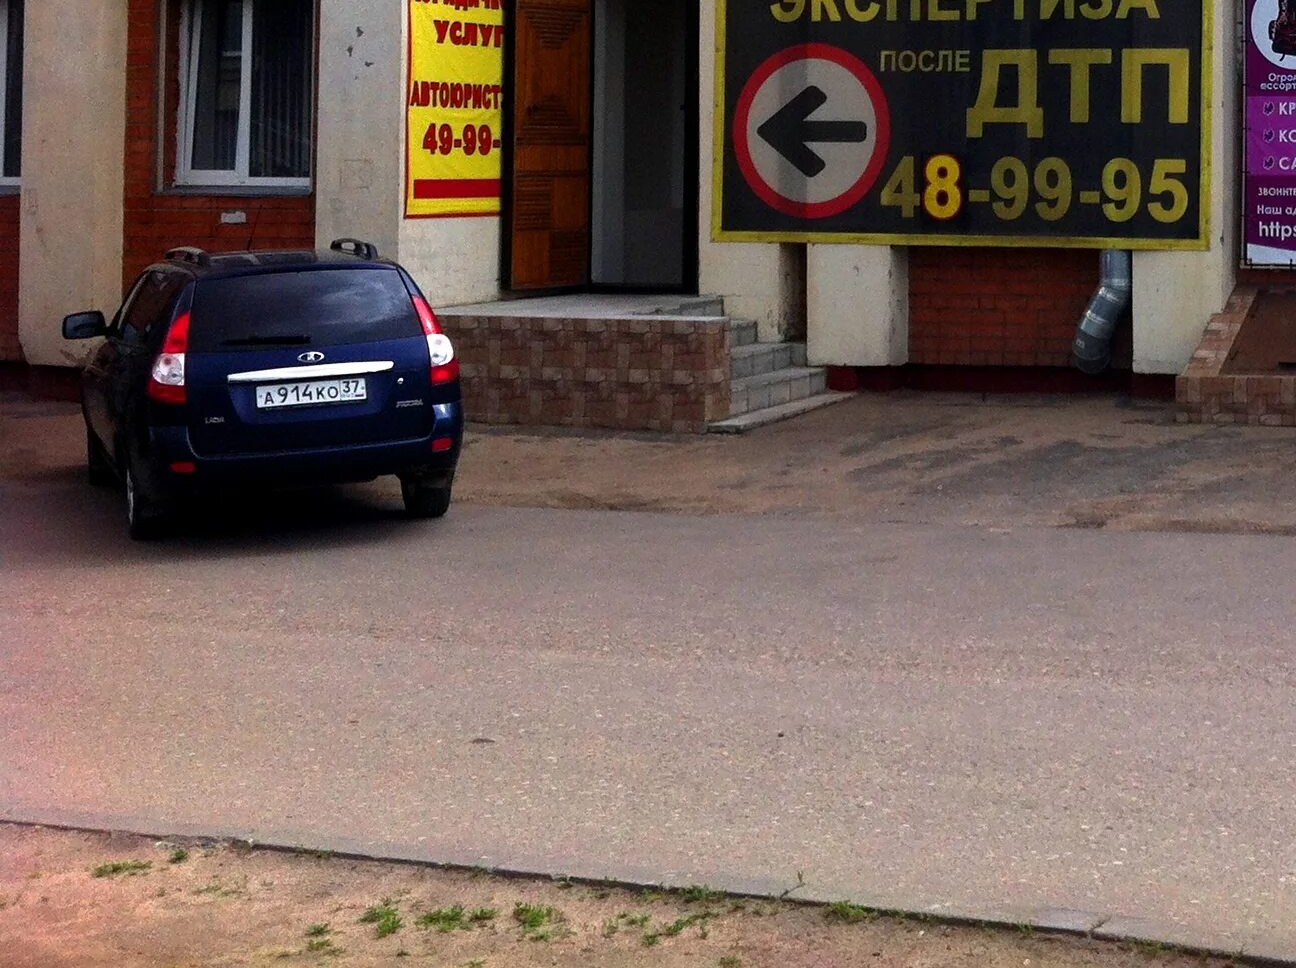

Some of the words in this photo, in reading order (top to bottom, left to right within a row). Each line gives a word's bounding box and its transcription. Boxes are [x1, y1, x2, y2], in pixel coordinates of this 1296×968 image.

[410, 80, 503, 110] АВТОЮРИСТ
[880, 49, 970, 73] ПОСЛЕ
[966, 47, 1190, 138] ДТП
[880, 153, 1190, 223] 48-99-95
[1257, 204, 1282, 216] Наш
[263, 384, 339, 406] А914КО
[342, 380, 359, 393] 37
